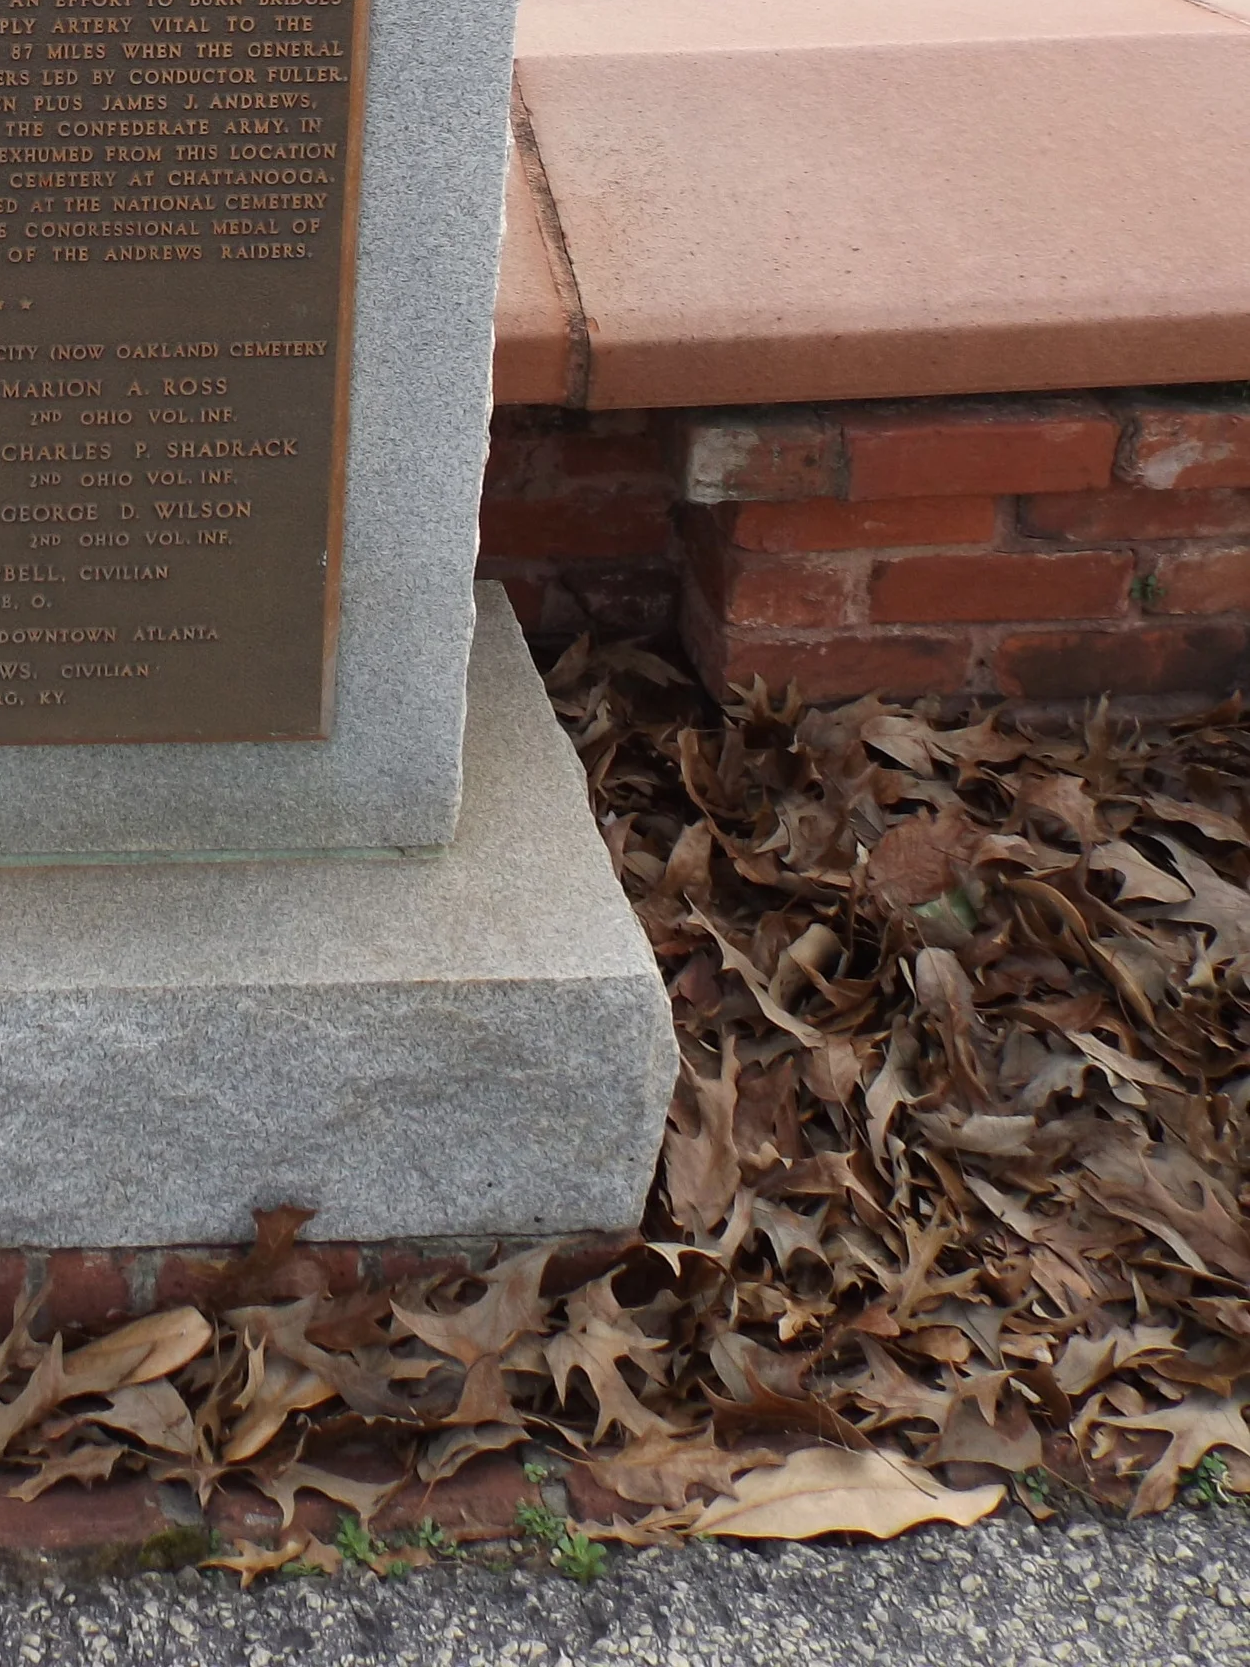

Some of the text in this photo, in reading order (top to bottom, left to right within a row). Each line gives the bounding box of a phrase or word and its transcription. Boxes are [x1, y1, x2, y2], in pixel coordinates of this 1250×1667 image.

[51, 17, 133, 34] ARTERY
[149, 16, 211, 32] VITAL
[226, 16, 256, 31] TO
[274, 15, 314, 31] THE
[10, 43, 33, 59] 87
[46, 43, 106, 59] MILES
[121, 42, 183, 58] WHEN
[195, 42, 233, 57] THE
[247, 40, 344, 57] GENERAL
[41, 69, 79, 85] LED
[91, 68, 116, 85] BY
[128, 67, 258, 84] CONDUCTOR
[266, 65, 348, 82] FULLER.
[33, 95, 83, 110] PLUS
[101, 94, 168, 110] JAMES
[183, 94, 199, 109] J.
[208, 92, 318, 110] ANDREWS,
[7, 246, 37, 262] OF
[51, 246, 89, 261] THE
[104, 244, 203, 260] ANDREWS
[220, 243, 313, 259] RAIDERS.
[0, 377, 228, 397] MARION A. ROSS
[1, 438, 298, 460] CHARLES P. SHADRACK
[0, 500, 252, 522] GEORGE D. WILSON
[79, 565, 169, 580] CIVILIAN
[132, 625, 220, 640] ATLANTA
[61, 663, 150, 678] CIVILIAN
